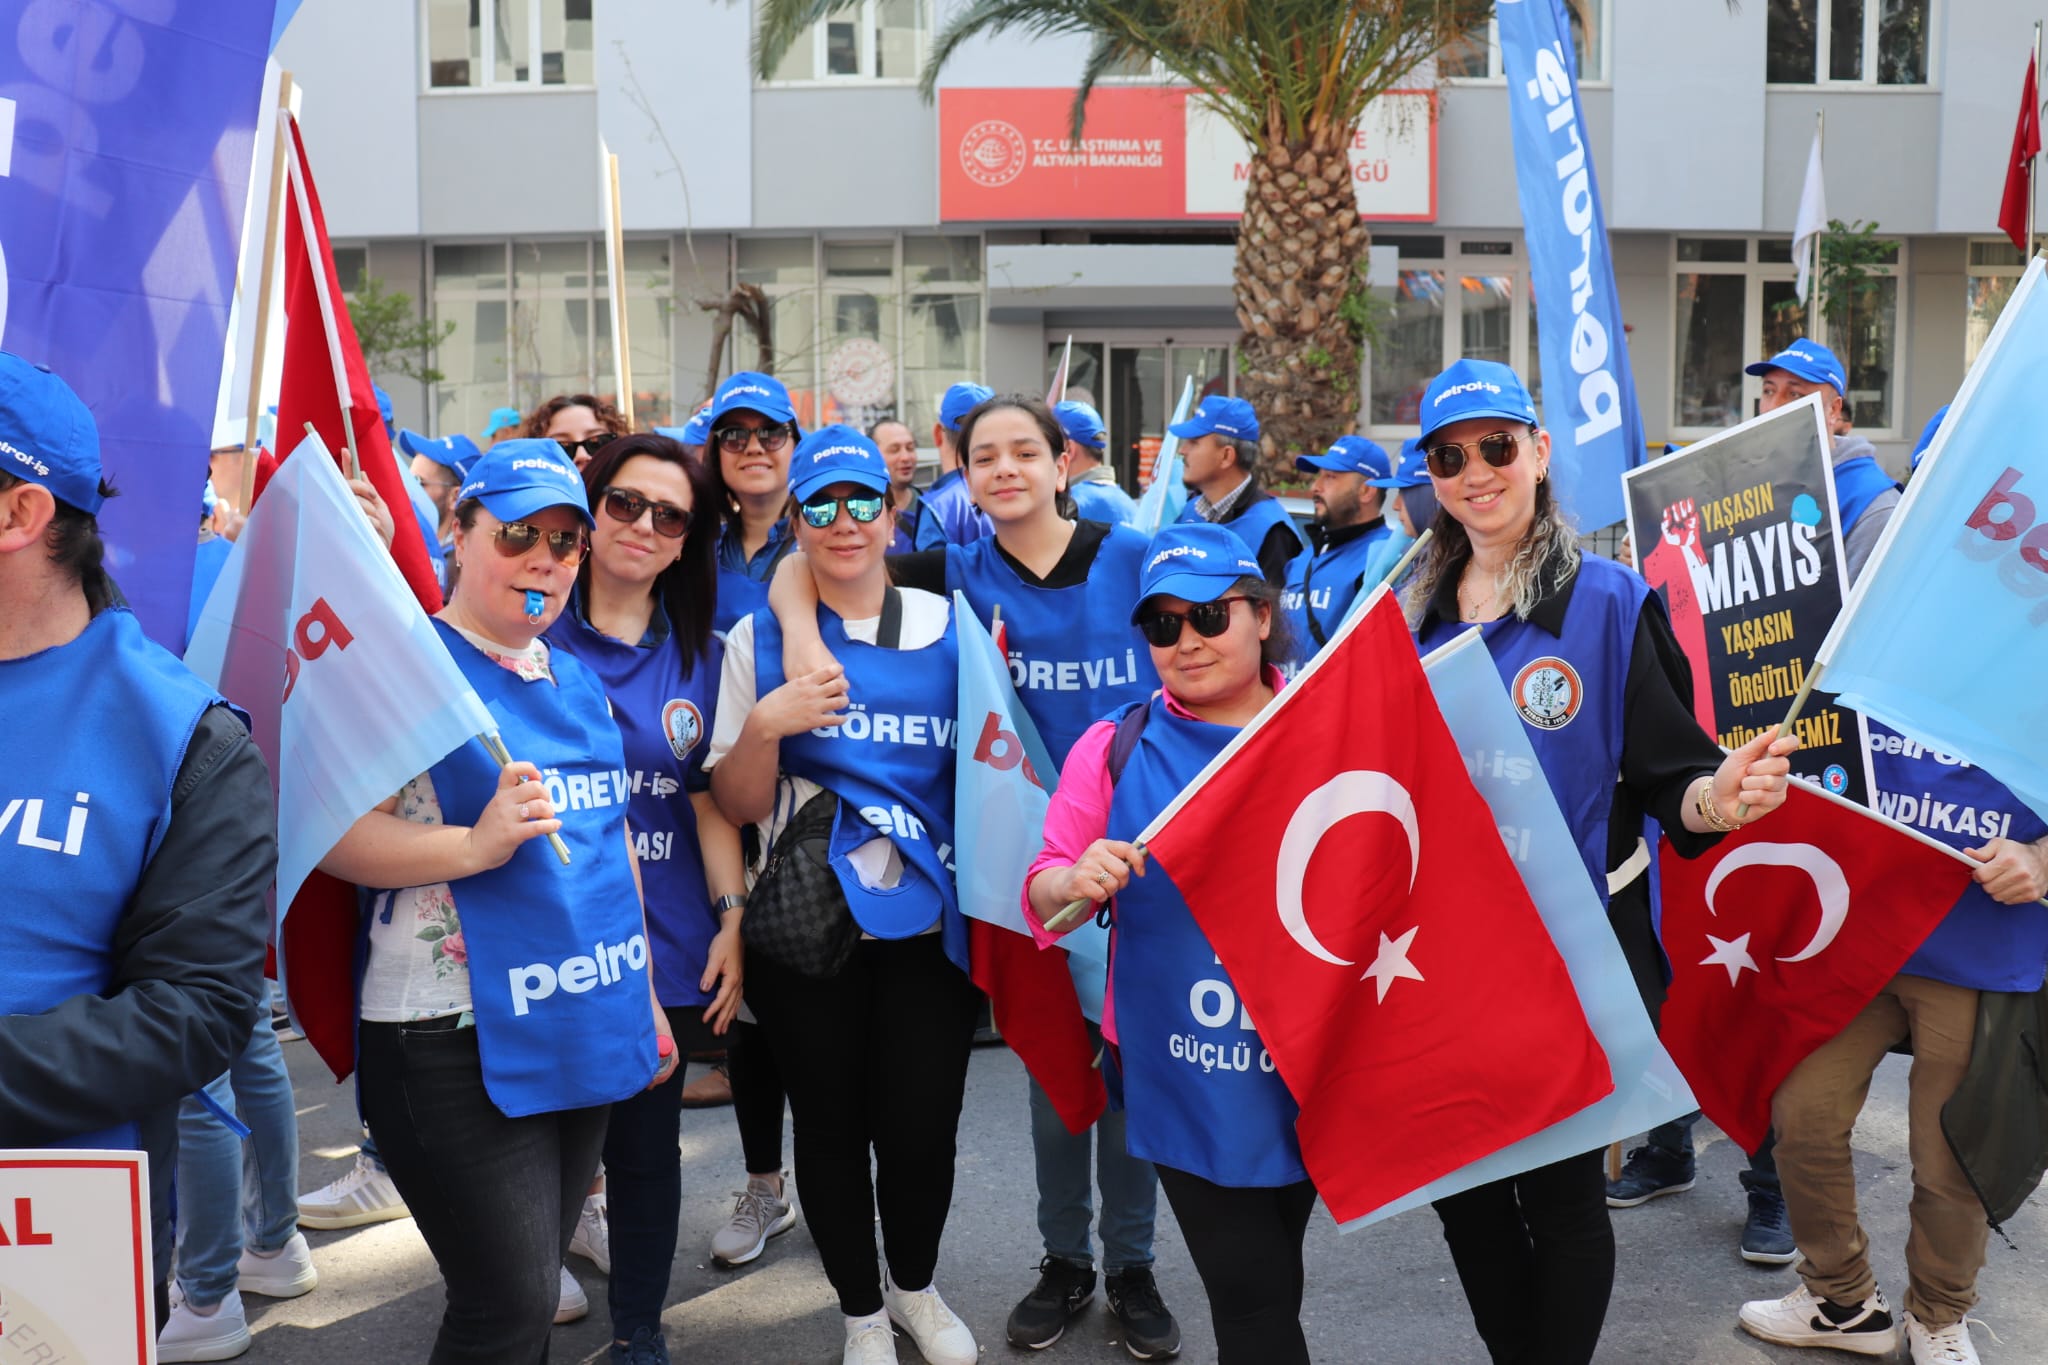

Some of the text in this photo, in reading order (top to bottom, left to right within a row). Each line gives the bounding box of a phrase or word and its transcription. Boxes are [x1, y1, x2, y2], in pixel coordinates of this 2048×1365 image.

[1060, 139, 1141, 154] UAŞTIRMA
[1144, 139, 1162, 152] VE
[1089, 152, 1163, 167] BAKANLIĞI
[1702, 481, 1775, 536] YAŞASIN
[1682, 521, 1822, 615] MAYIS
[1721, 609, 1794, 660] YAŞASIN
[1008, 648, 1137, 691] ÖREVLİ
[1728, 657, 1803, 708] ÖRGÜTLÜ
[1877, 790, 2012, 840] NDİKASI
[1169, 1033, 1250, 1073] GÜÇLÜ
